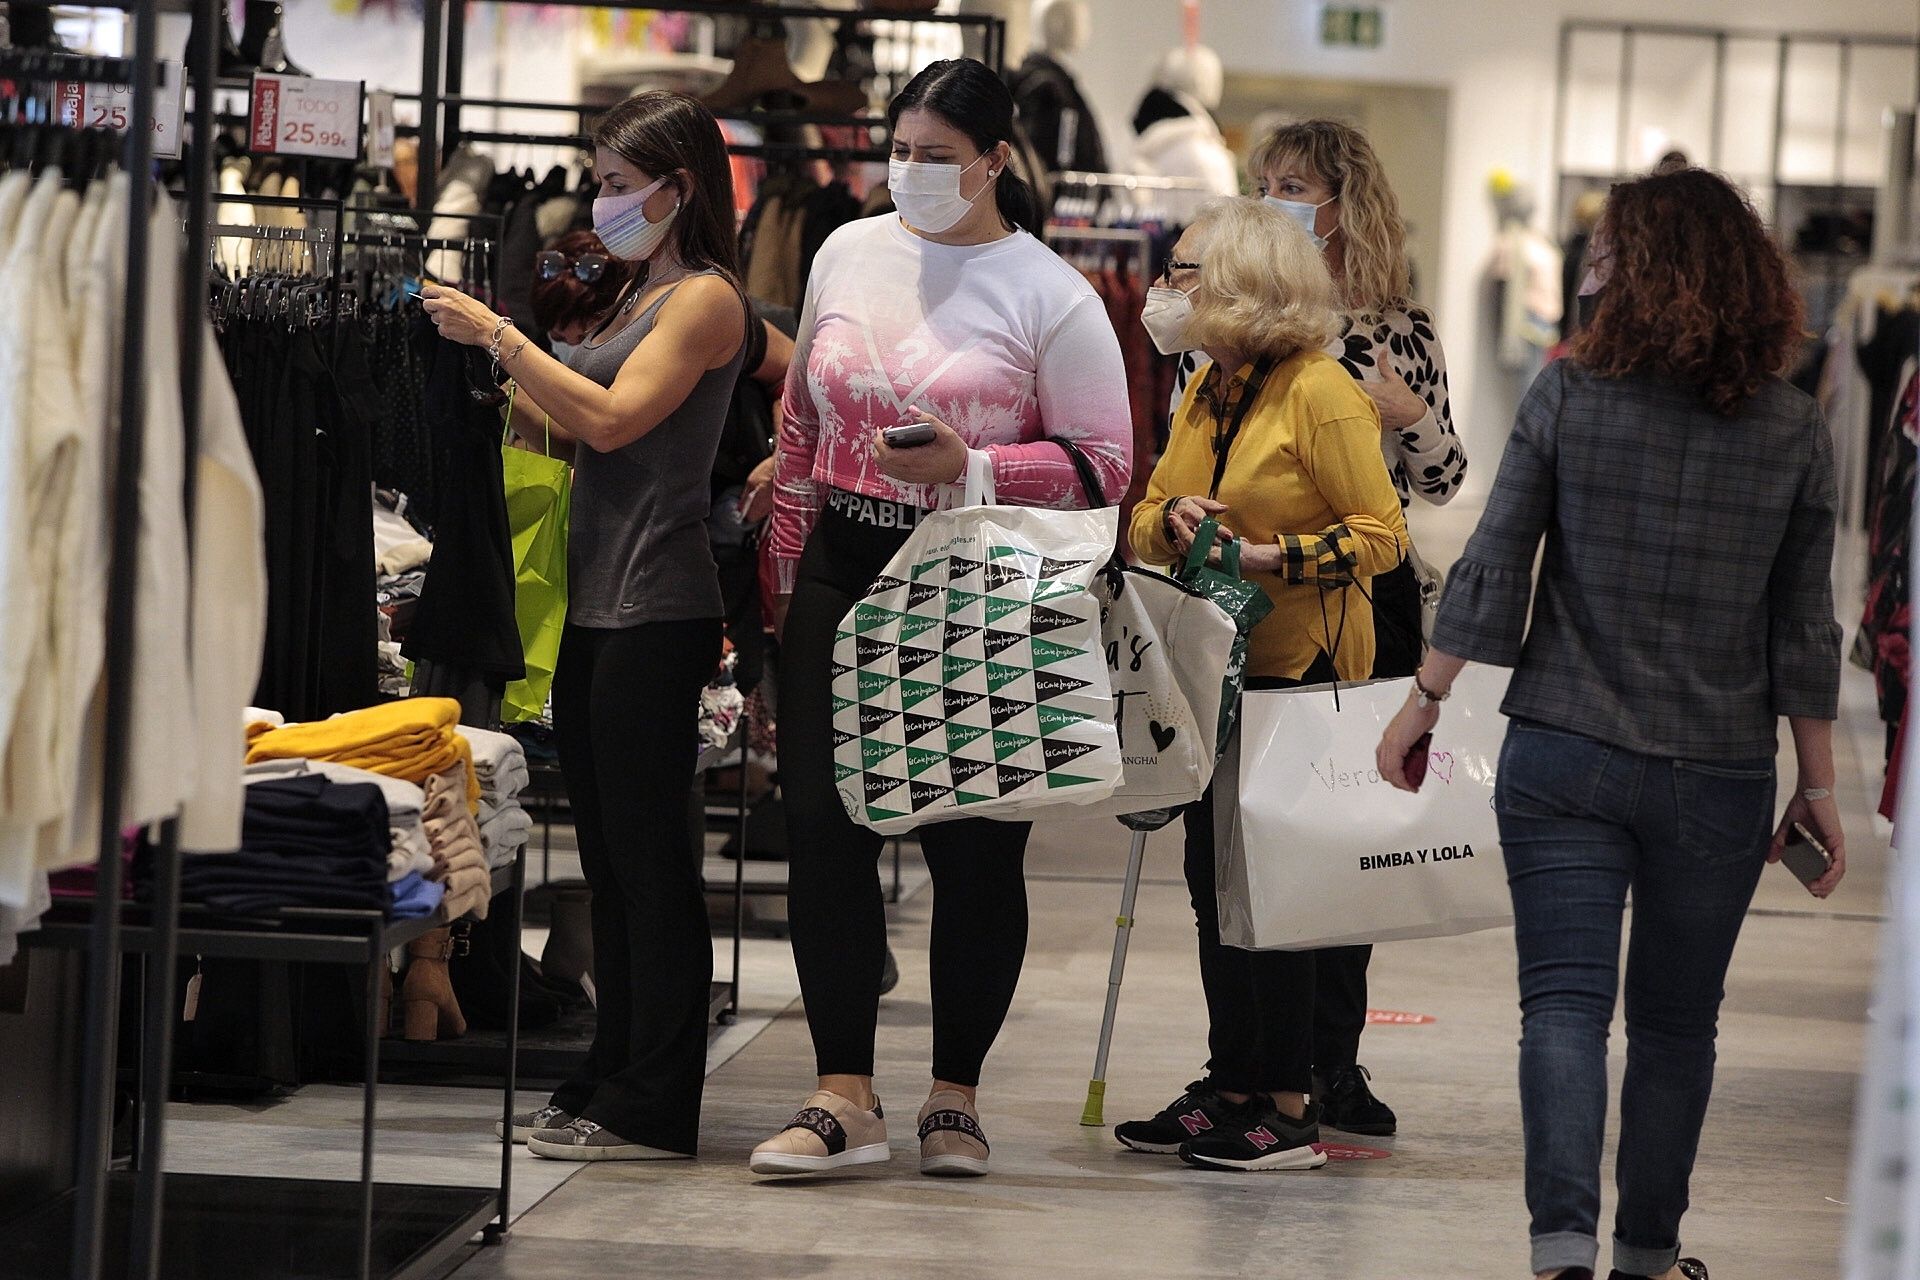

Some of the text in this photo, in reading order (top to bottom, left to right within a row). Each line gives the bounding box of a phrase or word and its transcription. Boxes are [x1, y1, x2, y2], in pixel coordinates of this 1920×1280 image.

[1121, 756, 1158, 765] ANGHAI
[1360, 844, 1474, 870] BIMBA Y LOLA
[1178, 1109, 1214, 1136] N
[1244, 1125, 1279, 1151] N
